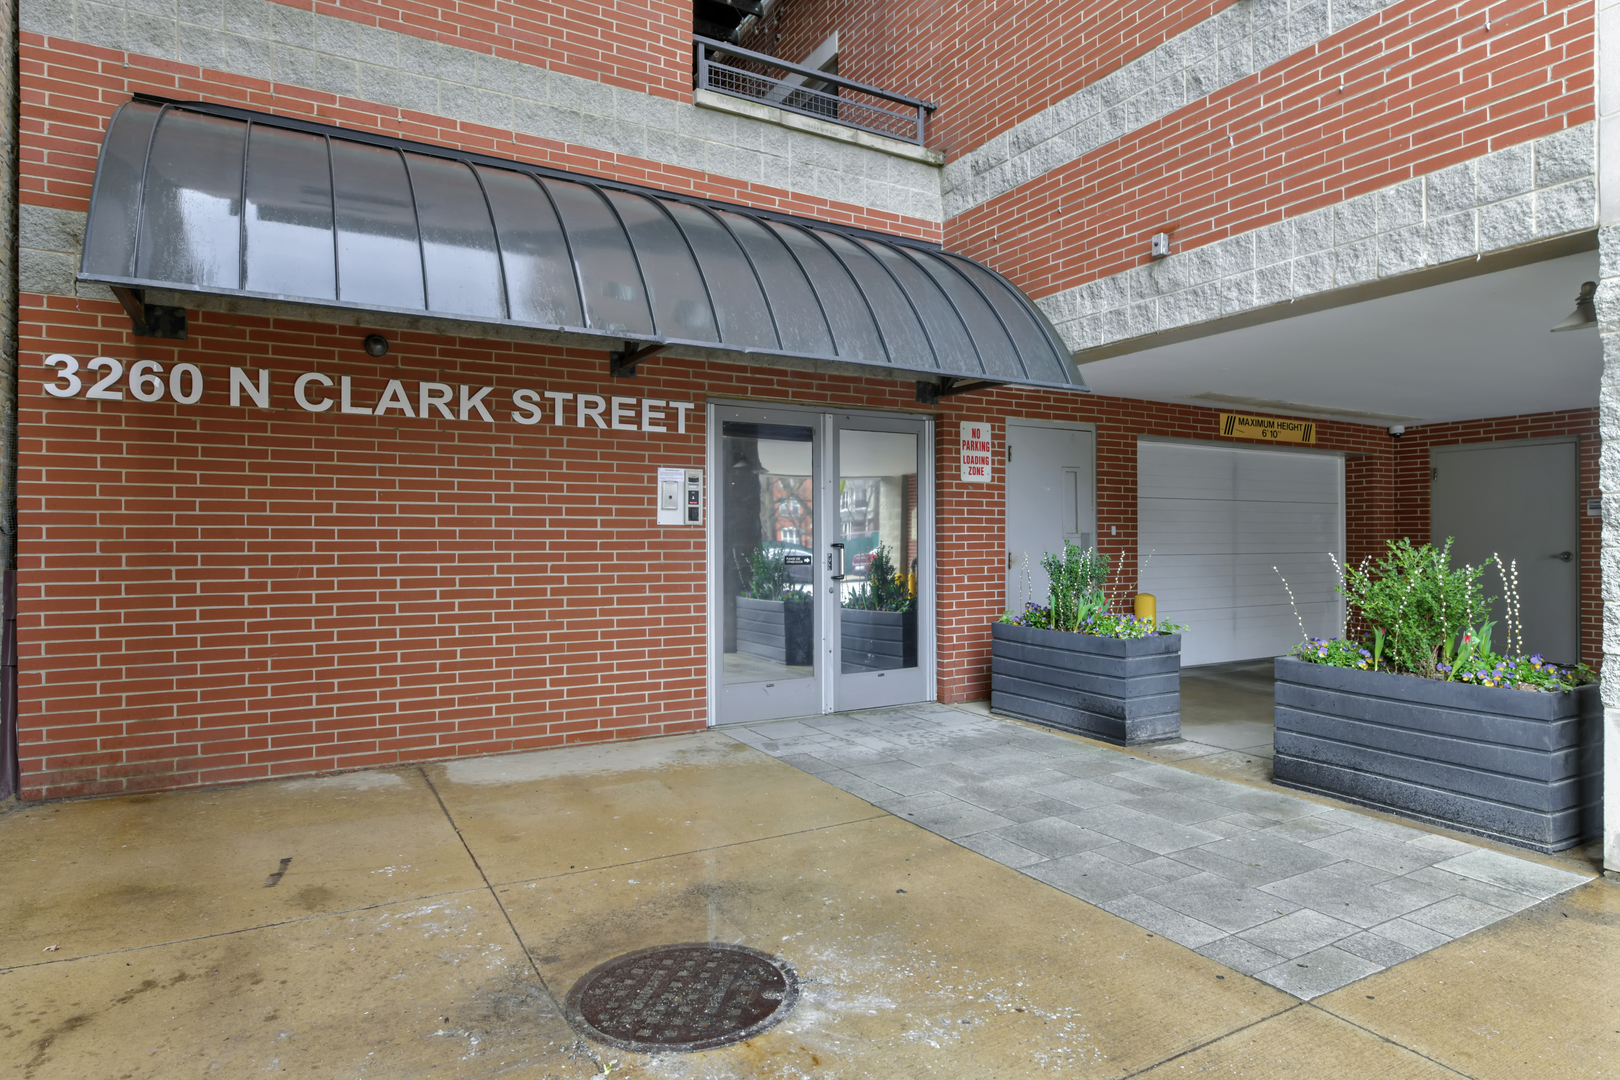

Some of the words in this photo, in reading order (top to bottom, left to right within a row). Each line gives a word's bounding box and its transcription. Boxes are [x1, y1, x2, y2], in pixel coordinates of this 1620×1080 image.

[43, 353, 203, 405] 3260
[229, 366, 270, 408] N
[293, 372, 496, 423] CLARK
[511, 388, 695, 434] STREET
[1238, 417, 1275, 429] MAXIMUM
[1276, 421, 1303, 432] HEIGHT
[971, 428, 981, 439] NO
[962, 439, 990, 452] PARKING
[962, 455, 990, 465] LOADING
[968, 466, 984, 476] ZONE
